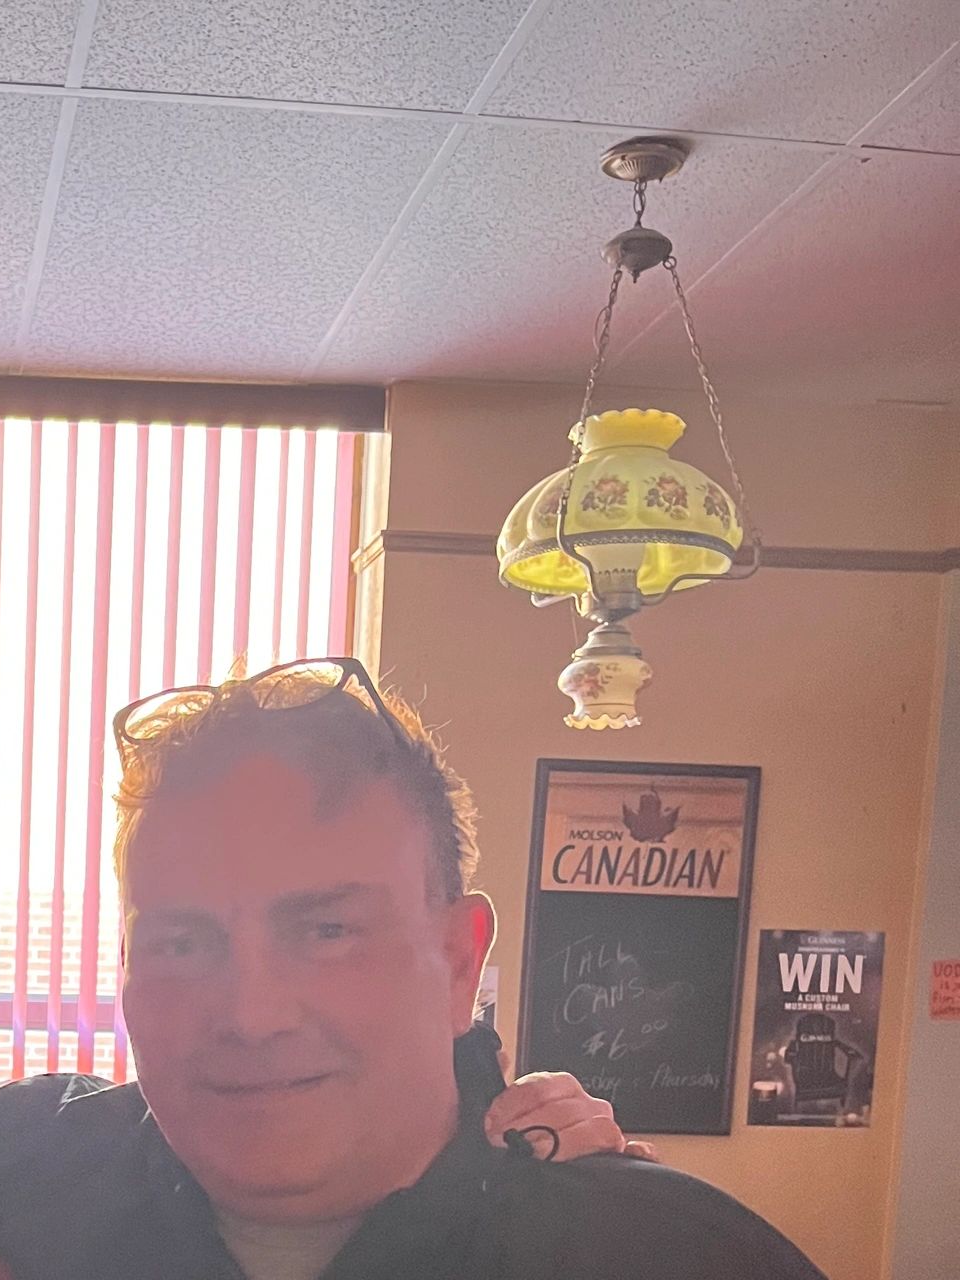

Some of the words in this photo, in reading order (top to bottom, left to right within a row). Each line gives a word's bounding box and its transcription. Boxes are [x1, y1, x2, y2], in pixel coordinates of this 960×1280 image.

[569, 829, 624, 842] MOLSON
[552, 845, 725, 889] CANADIAN
[778, 953, 864, 993] WIN
[797, 994, 803, 1002] A
[805, 994, 838, 1002] CUSTOM
[825, 1003, 850, 1011] CHAIR
